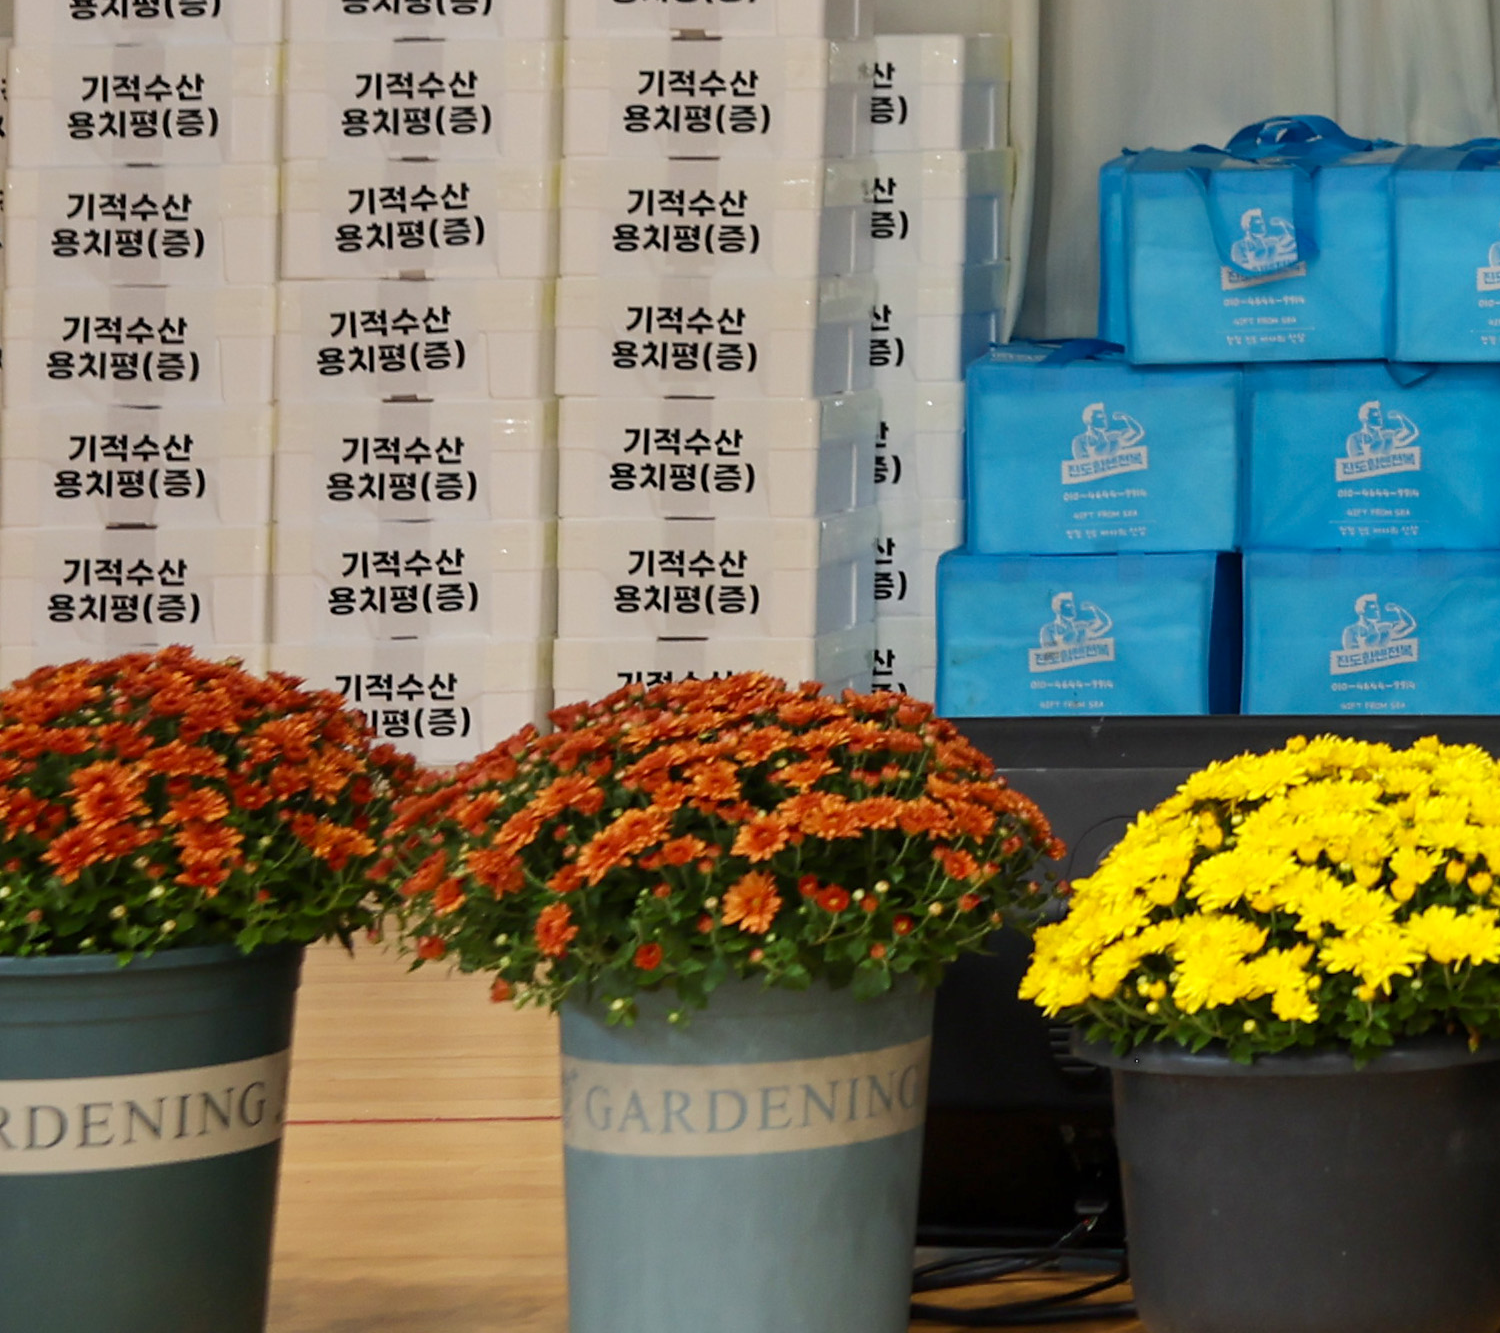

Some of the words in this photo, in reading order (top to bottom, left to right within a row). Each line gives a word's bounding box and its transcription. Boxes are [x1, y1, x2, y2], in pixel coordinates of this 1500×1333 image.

[82, 74, 204, 103] 기적수산
[356, 71, 477, 100] 기적수산
[638, 70, 758, 97] 기적수산
[68, 108, 218, 139] 용치평(증)
[342, 105, 491, 137] 용치평(증)
[624, 105, 770, 134] 용치평(증)
[67, 194, 192, 221] 기적수산
[349, 183, 469, 215] 기적수산
[628, 190, 747, 217] 기적수산
[52, 228, 204, 258] 용치평(증)
[336, 212, 484, 250] 용치평(증)
[613, 224, 759, 254] 용치평(증)
[63, 317, 187, 344] 기적수산
[330, 306, 451, 338] 기적수산
[627, 307, 745, 335] 기적수산
[47, 351, 199, 381] 용치평(증)
[317, 340, 465, 375] 용치평(증)
[612, 341, 757, 372] 용치평(증)
[69, 434, 193, 462] 기적수산
[342, 437, 464, 465] 기적수산
[624, 428, 743, 456] 기적수산
[54, 469, 205, 499] 용치평(증)
[327, 471, 476, 501] 용치평(증)
[610, 463, 755, 493] 용치평(증)
[64, 559, 187, 586] 기적수산
[342, 548, 464, 578] 기적수산
[629, 550, 747, 577] 기적수산
[48, 593, 200, 624] 용치평(증)
[328, 582, 478, 615] 용치평(증)
[614, 585, 759, 614] 용치평(증)
[335, 674, 457, 701] 기적수산
